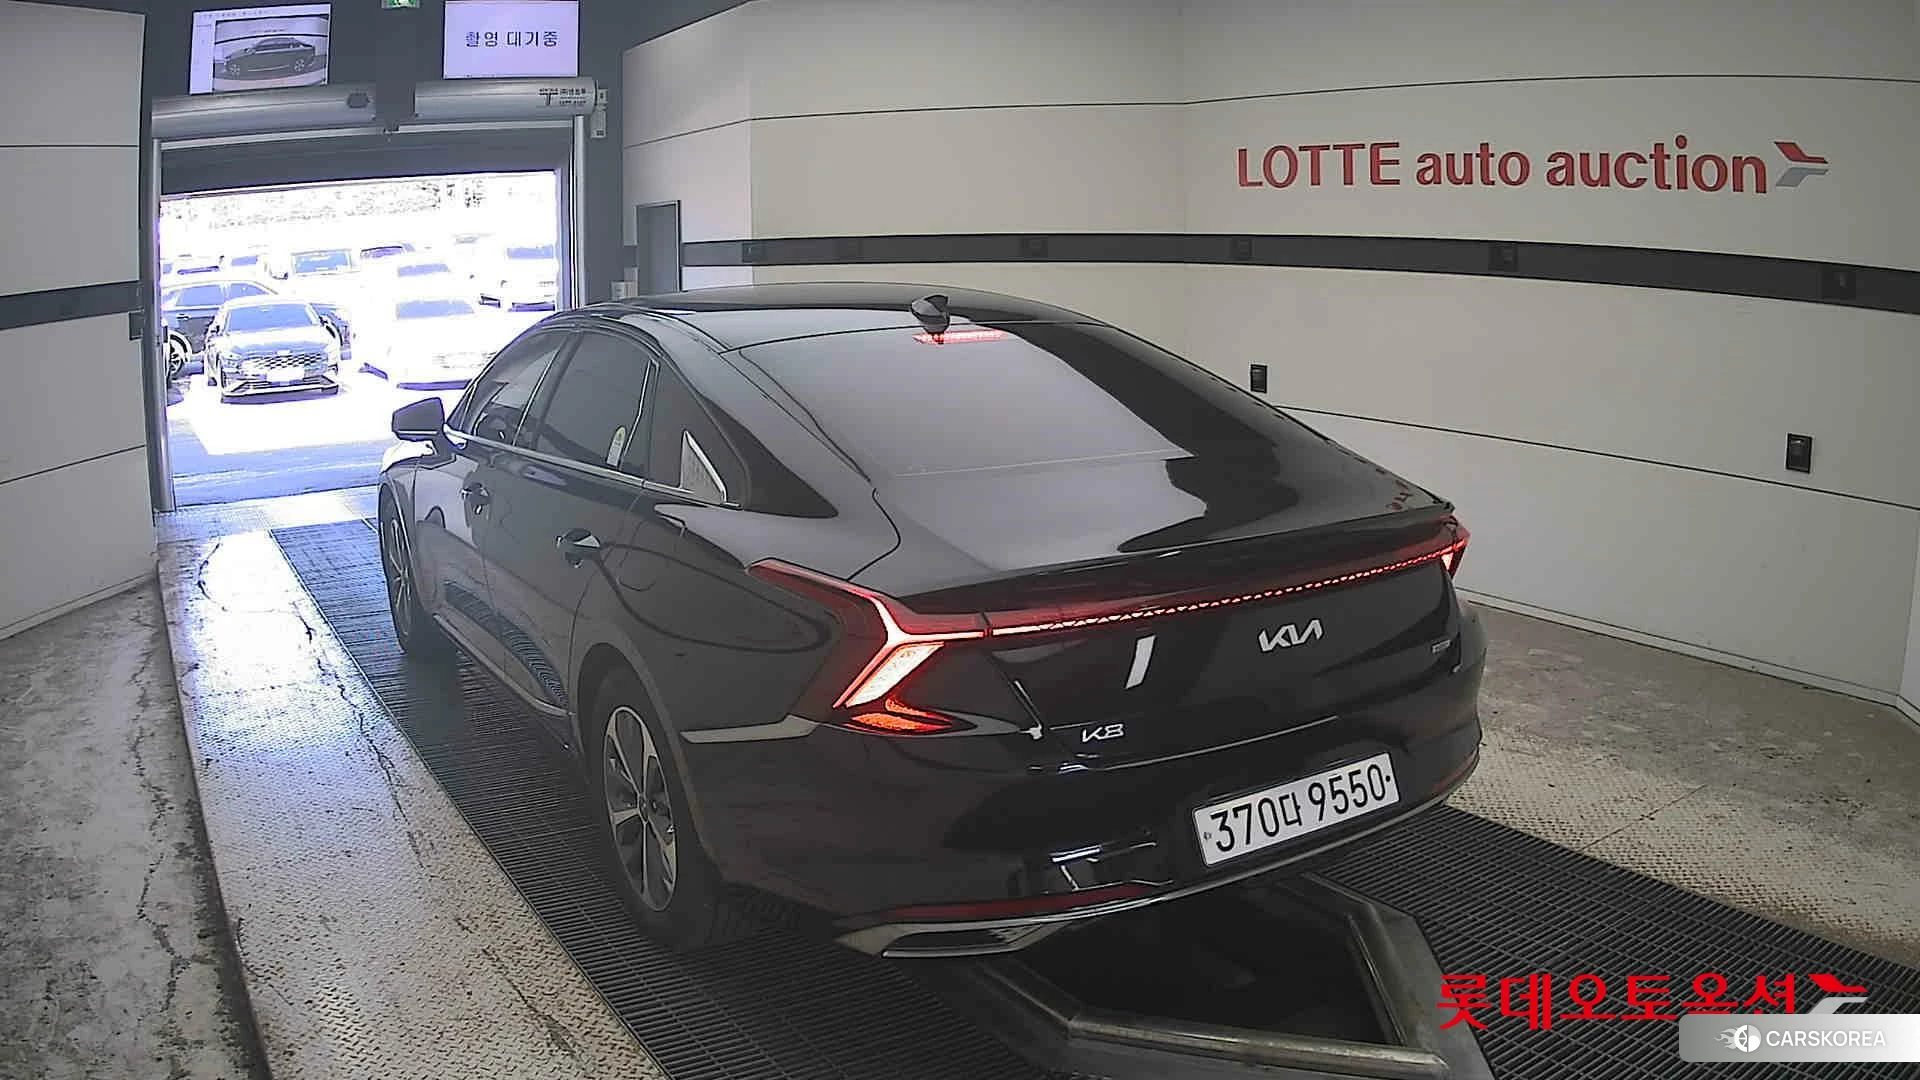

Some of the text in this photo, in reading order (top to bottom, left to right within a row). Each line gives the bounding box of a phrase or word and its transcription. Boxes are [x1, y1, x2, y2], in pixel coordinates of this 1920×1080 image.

[507, 31, 558, 48] 대기중
[1237, 135, 1767, 194] LOTTE auto auction
[1082, 724, 1124, 742] K8
[1210, 763, 1386, 852] 370다 9550
